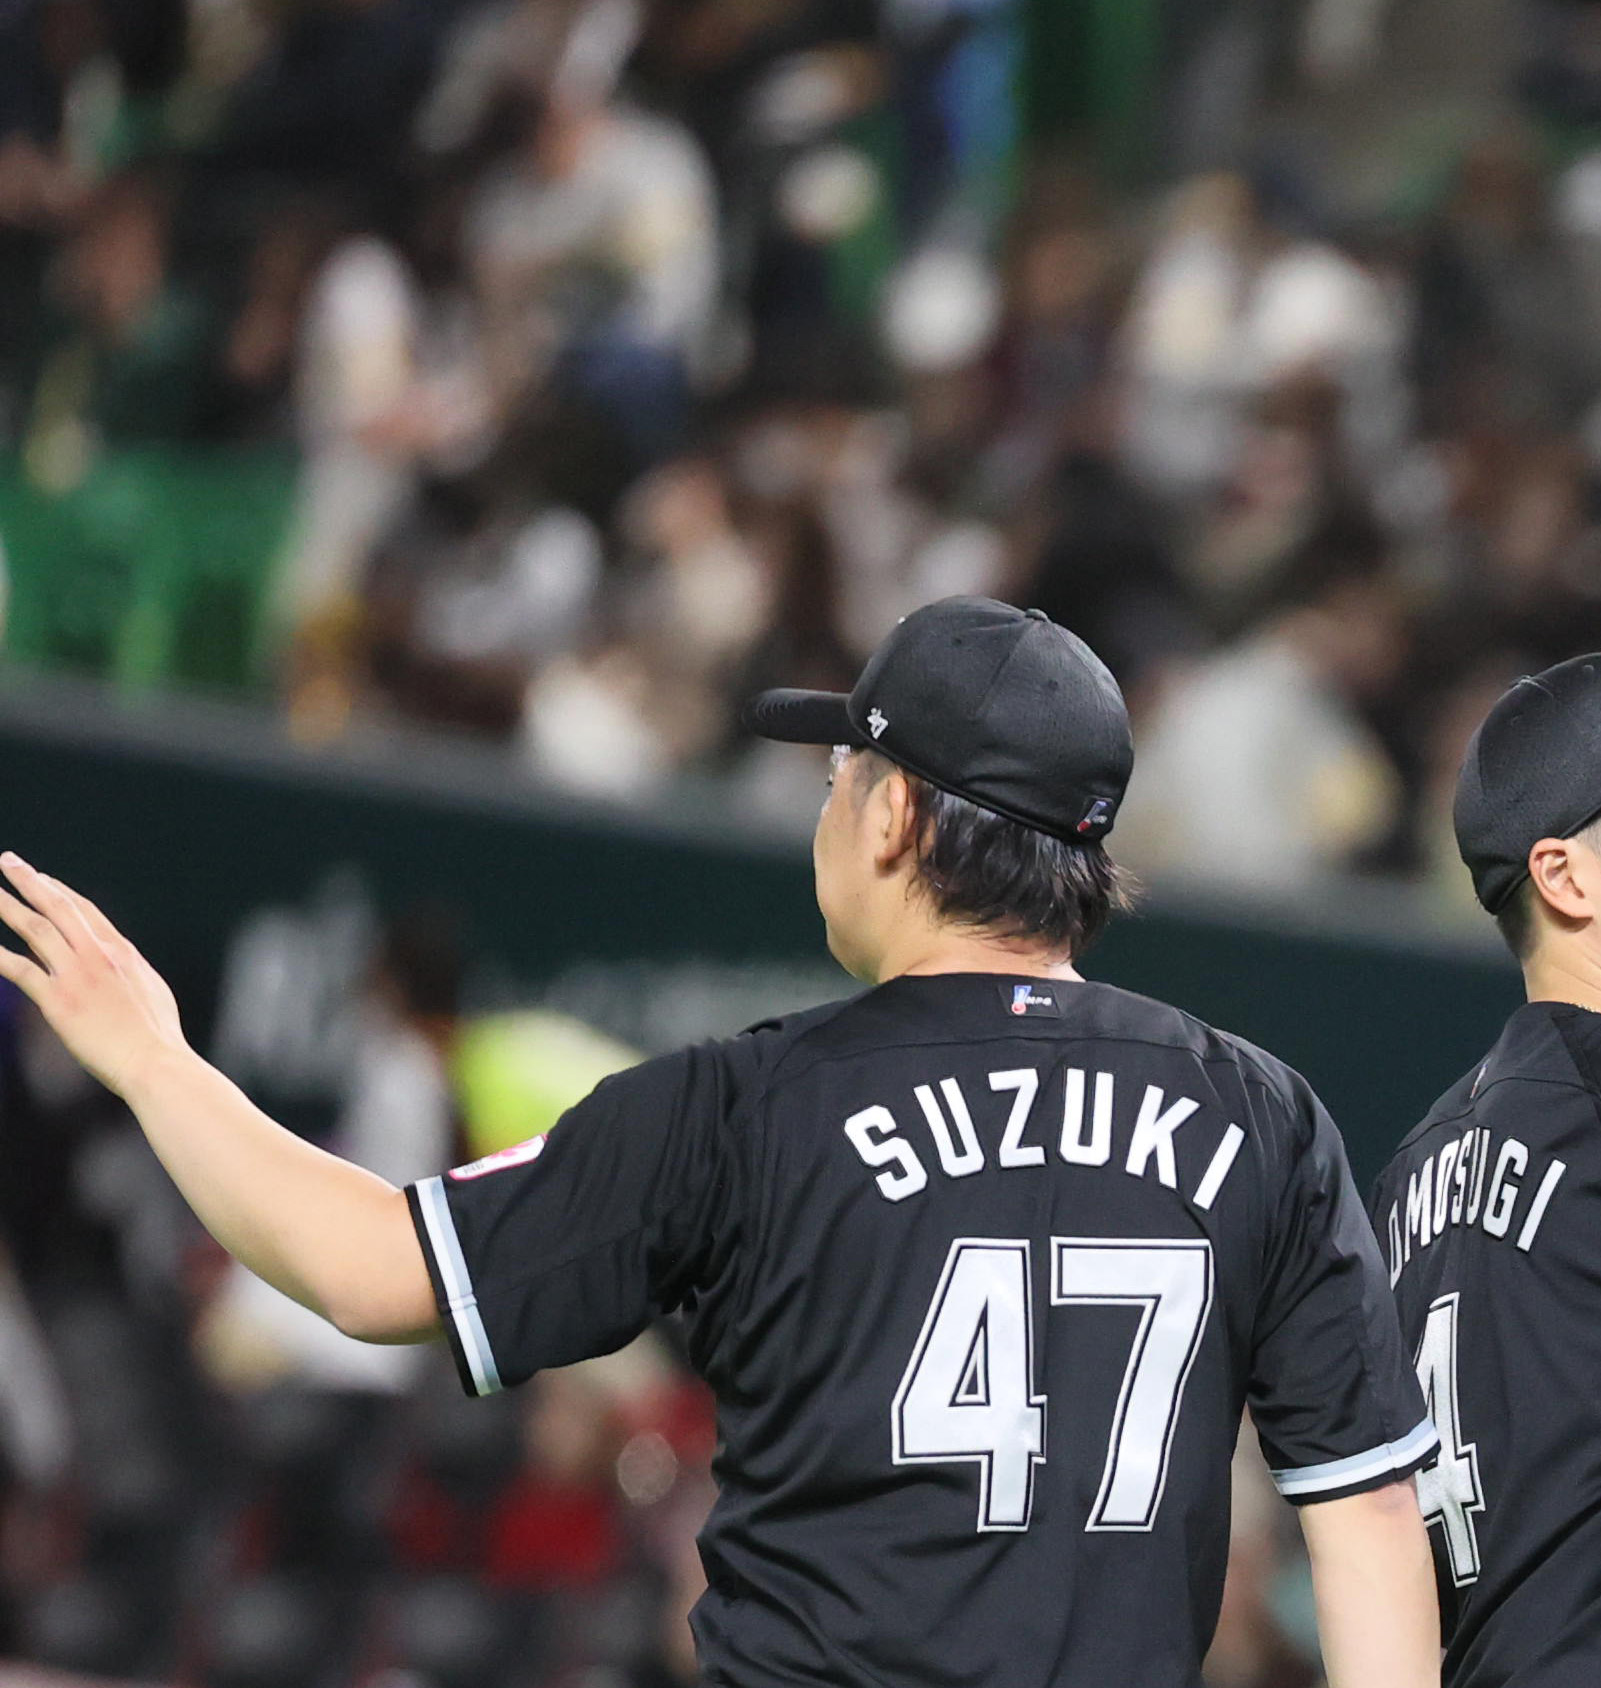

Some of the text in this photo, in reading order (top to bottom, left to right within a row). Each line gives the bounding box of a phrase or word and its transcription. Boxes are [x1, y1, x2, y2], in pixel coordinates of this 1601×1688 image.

[843, 1066, 1246, 1212] SUZUKI
[1388, 1126, 1567, 1292] OMOSUGI
[891, 1236, 1215, 1533] 47
[1413, 1291, 1486, 1589] 4
